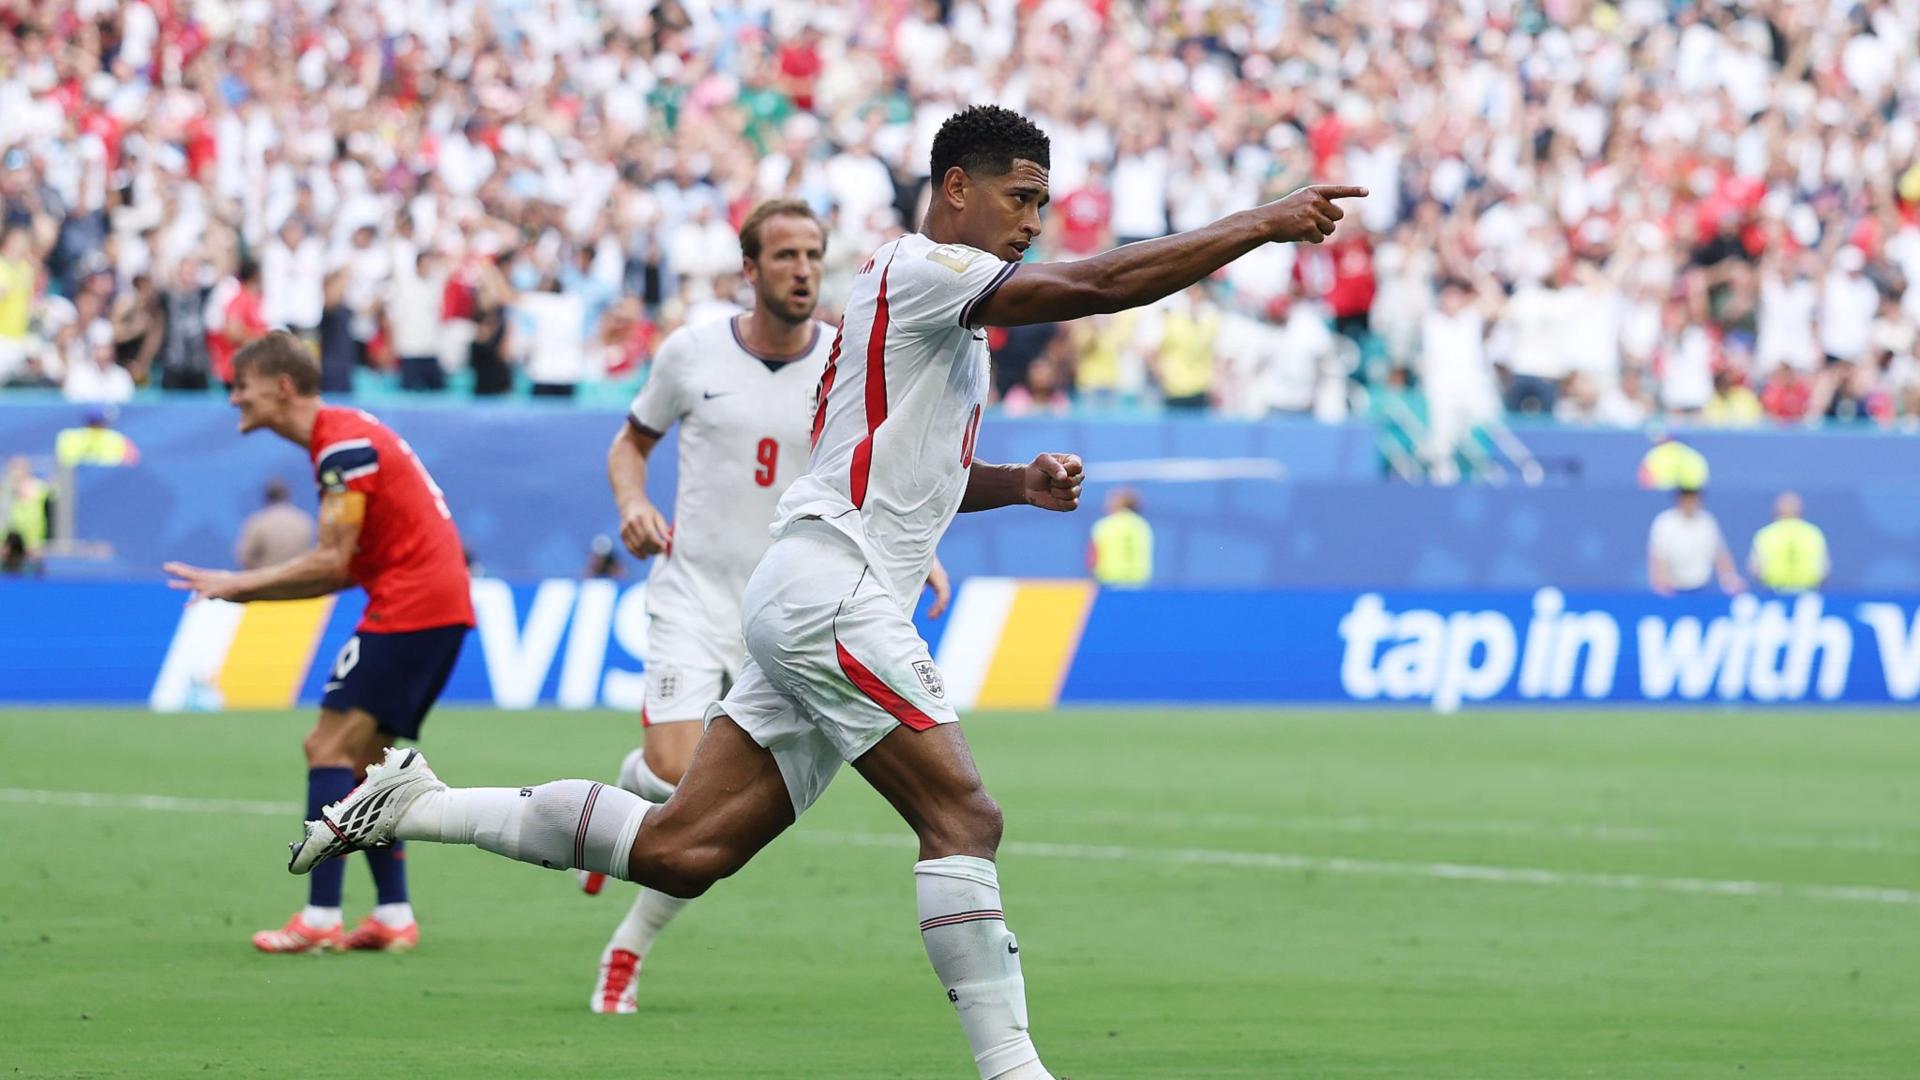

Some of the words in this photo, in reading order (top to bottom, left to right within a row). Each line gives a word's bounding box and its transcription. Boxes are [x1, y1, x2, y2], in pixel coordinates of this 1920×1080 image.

[754, 436, 779, 488] 9
[470, 577, 648, 710] VIS
[1339, 593, 1517, 714] tap
[1518, 586, 1620, 699] in
[1636, 591, 1854, 701] with
[1855, 602, 1920, 700] V
